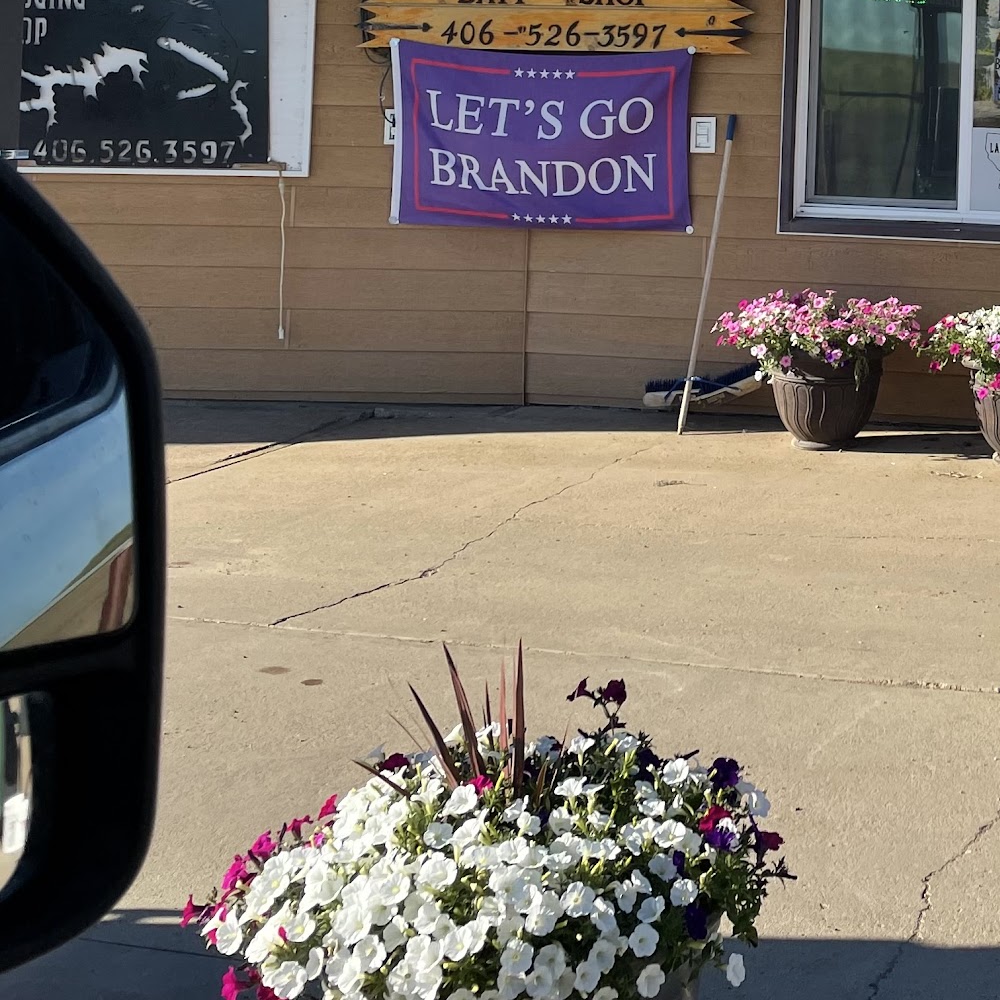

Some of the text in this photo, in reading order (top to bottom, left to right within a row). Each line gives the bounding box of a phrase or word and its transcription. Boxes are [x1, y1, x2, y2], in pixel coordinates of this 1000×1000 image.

[426, 88, 654, 141] LET'S GO
[33, 139, 236, 164] 406.526.3597
[429, 148, 657, 198] BRANDON
